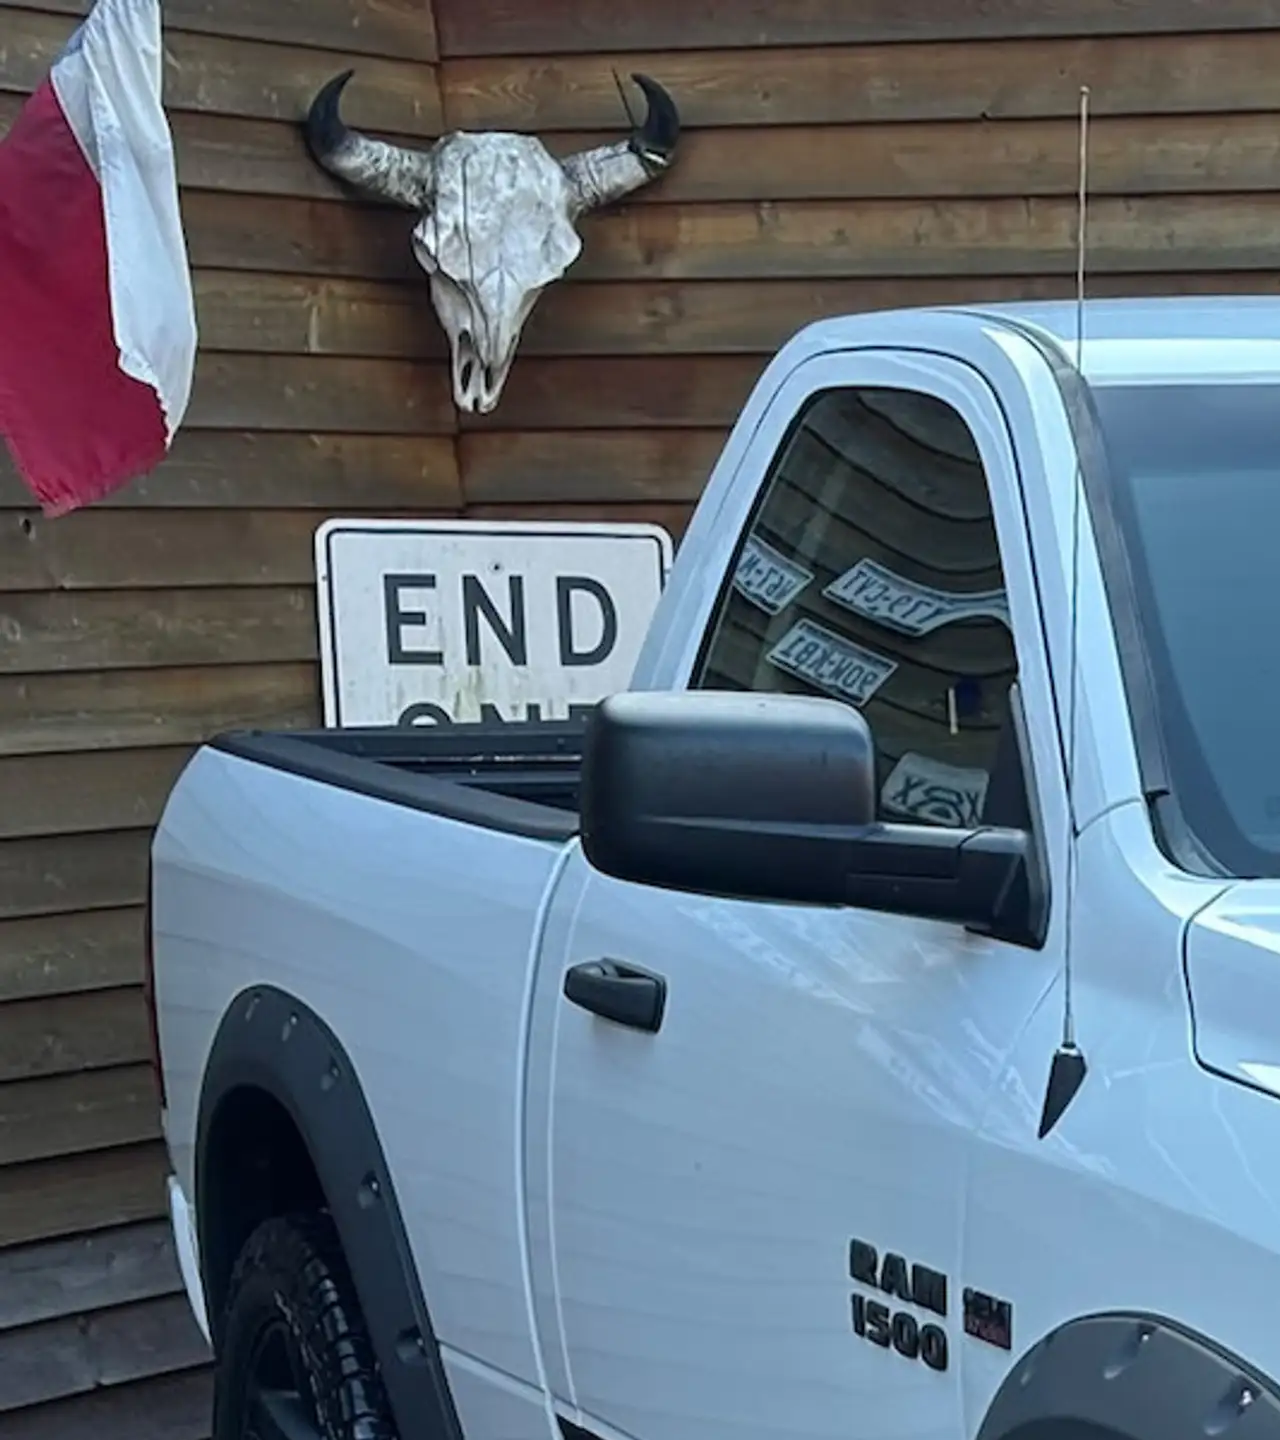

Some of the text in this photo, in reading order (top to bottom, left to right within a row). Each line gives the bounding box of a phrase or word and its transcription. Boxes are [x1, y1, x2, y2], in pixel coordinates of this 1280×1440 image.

[381, 572, 618, 668] END
[850, 1237, 947, 1317] RAM
[852, 1293, 947, 1372] 1500
